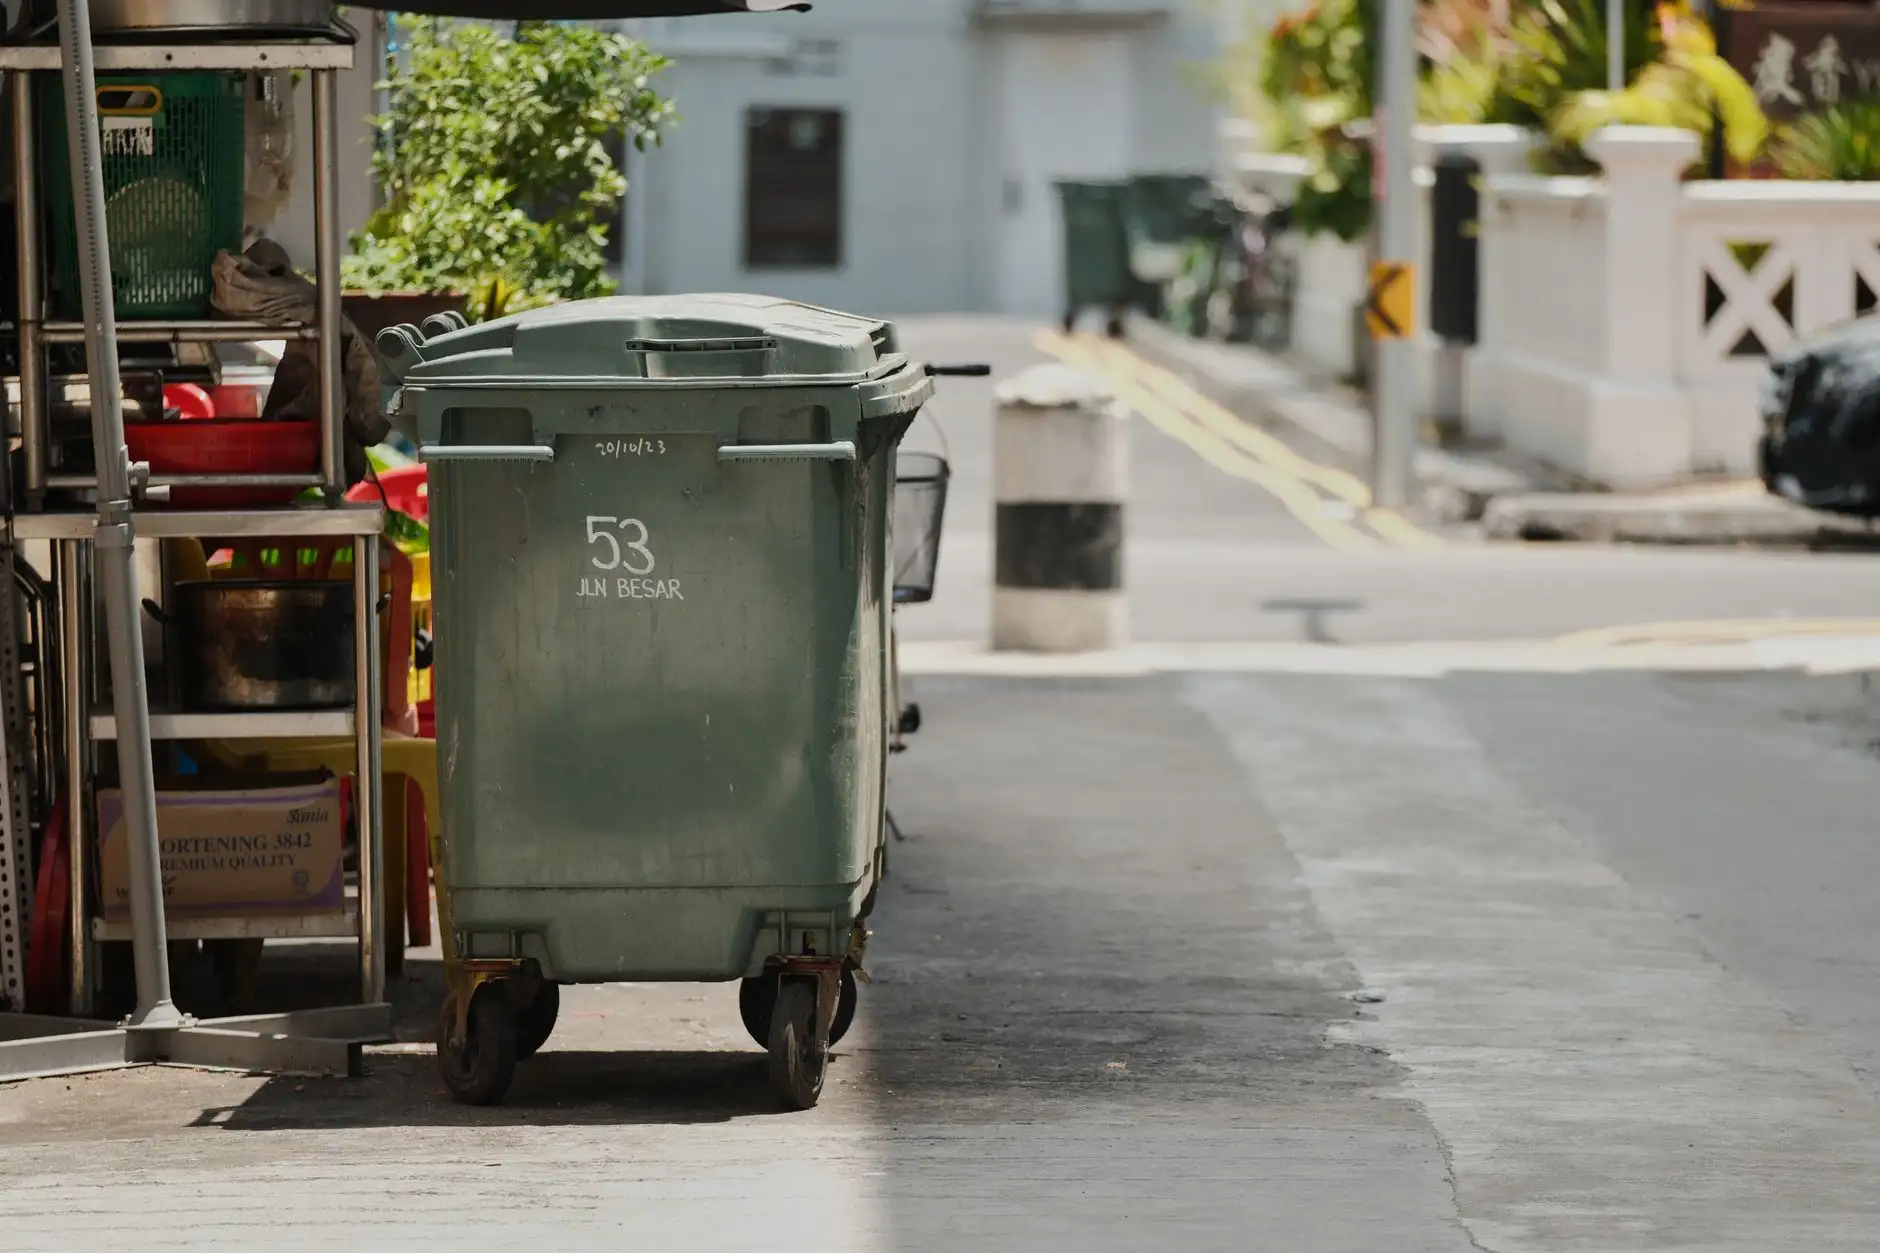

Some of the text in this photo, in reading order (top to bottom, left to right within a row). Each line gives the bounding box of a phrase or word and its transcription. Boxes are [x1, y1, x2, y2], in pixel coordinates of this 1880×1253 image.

[595, 437, 666, 459] 20/10/23
[586, 515, 655, 575] 53
[576, 577, 684, 600] JLN BESAR
[161, 832, 312, 854] ORTENING 3842
[160, 853, 297, 872] REMIUM QUALITY
